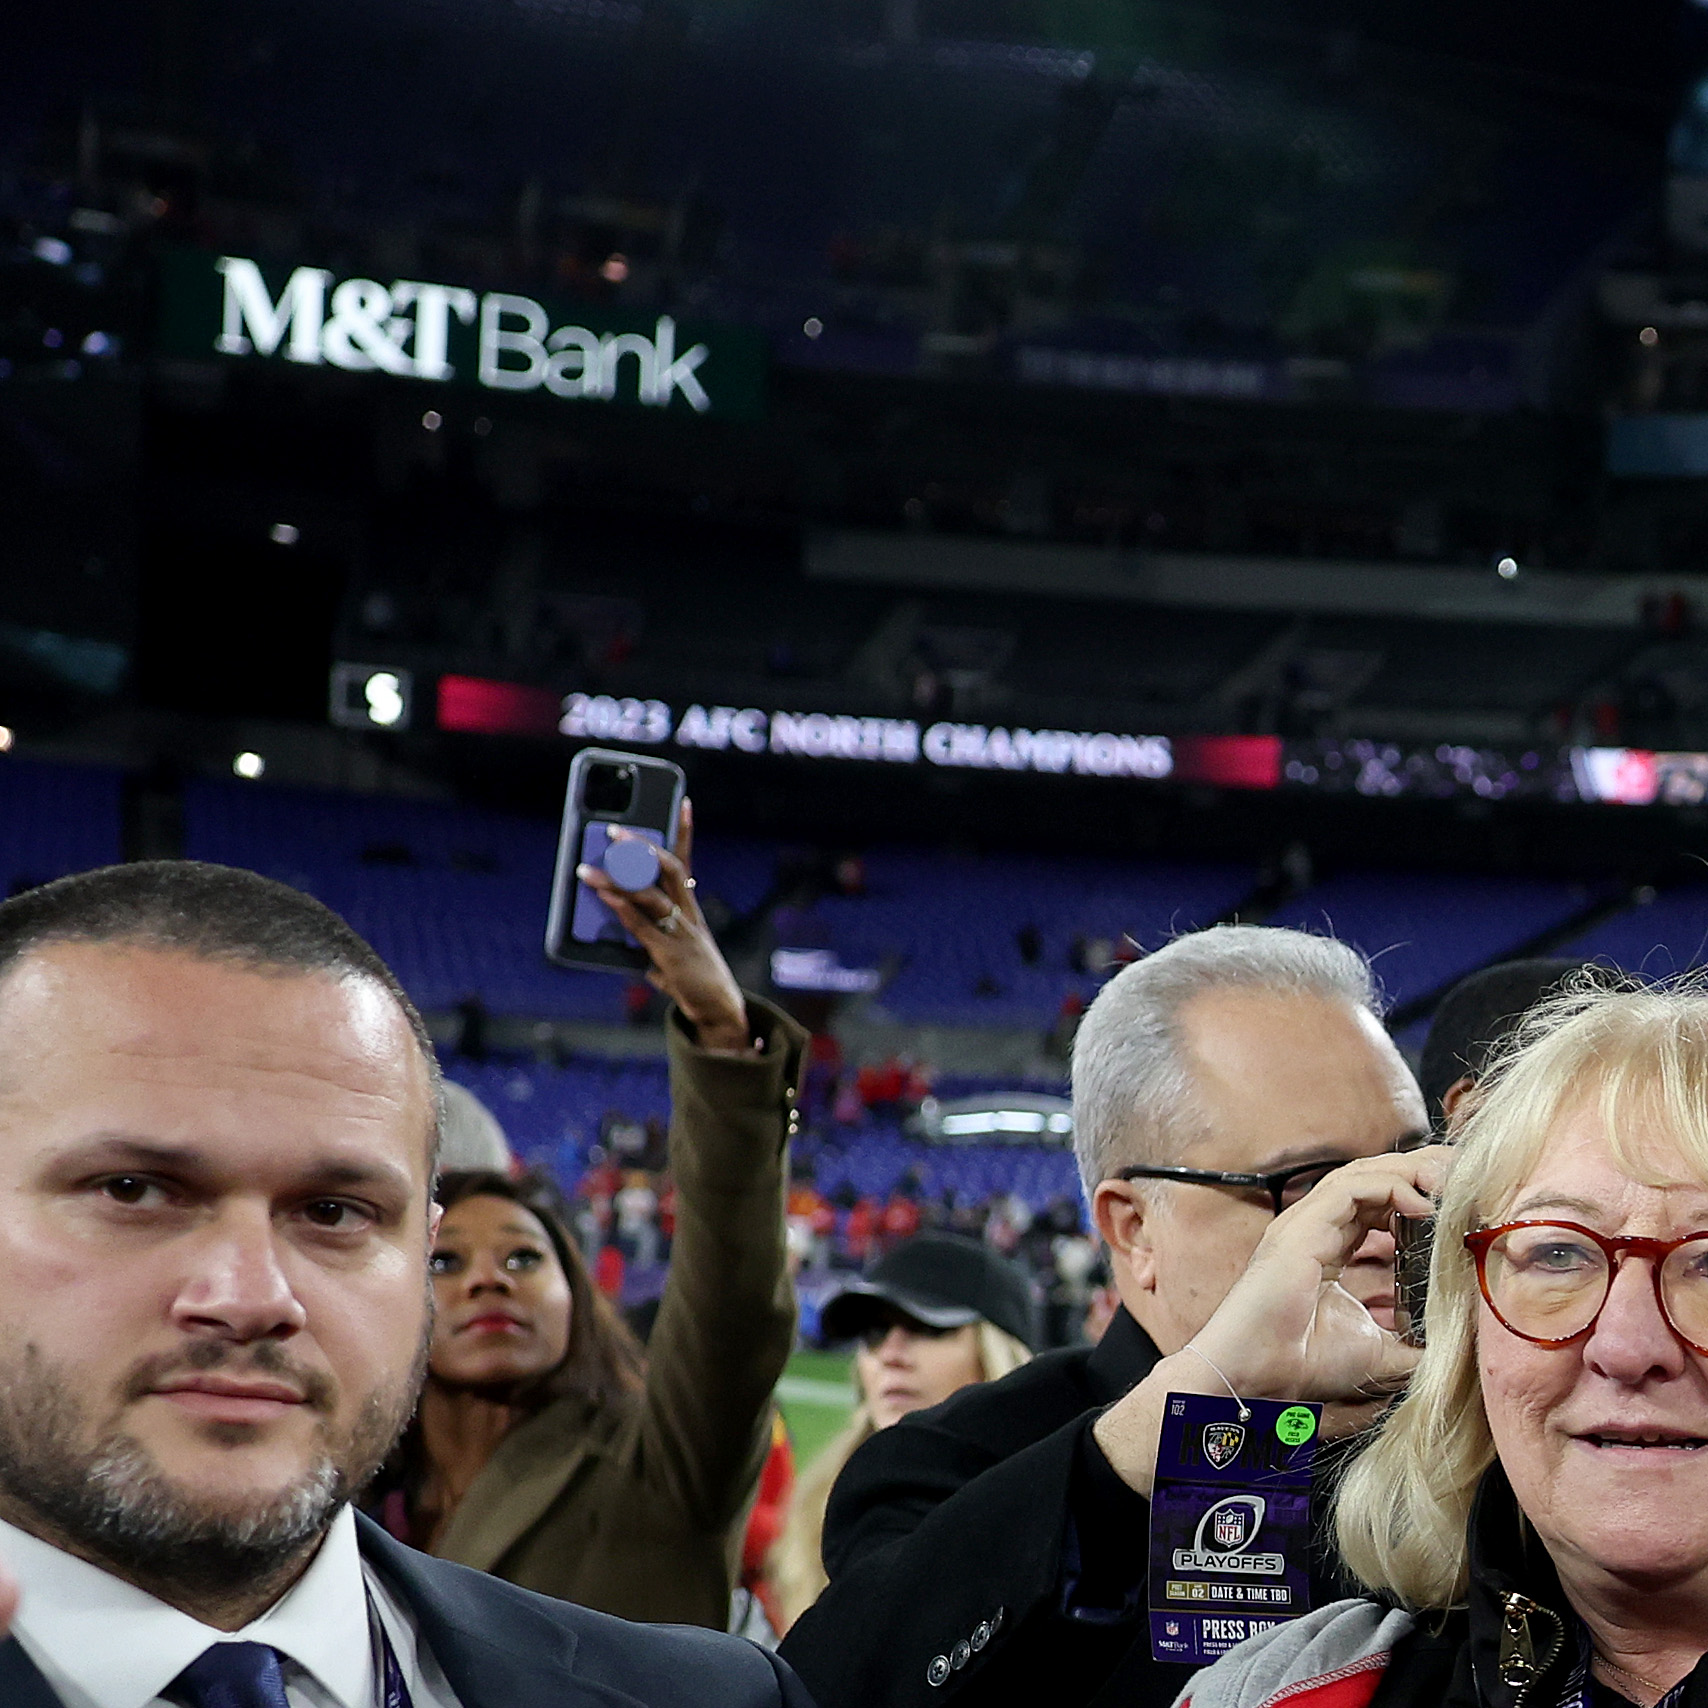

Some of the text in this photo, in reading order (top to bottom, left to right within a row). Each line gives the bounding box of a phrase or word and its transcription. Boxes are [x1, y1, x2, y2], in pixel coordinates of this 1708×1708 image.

[214, 255, 711, 412] M&T Bank
[557, 691, 1174, 779] 2023 AFC NORTH CHAMPIONS
[1171, 1404, 1185, 1416] 102
[1217, 1525, 1241, 1542] NFL
[1181, 1554, 1276, 1570] PLAYOFFS
[1191, 1589, 1204, 1598] 02
[1211, 1586, 1287, 1601] DATE & TIME TBD
[1202, 1619, 1245, 1639] PRESS
